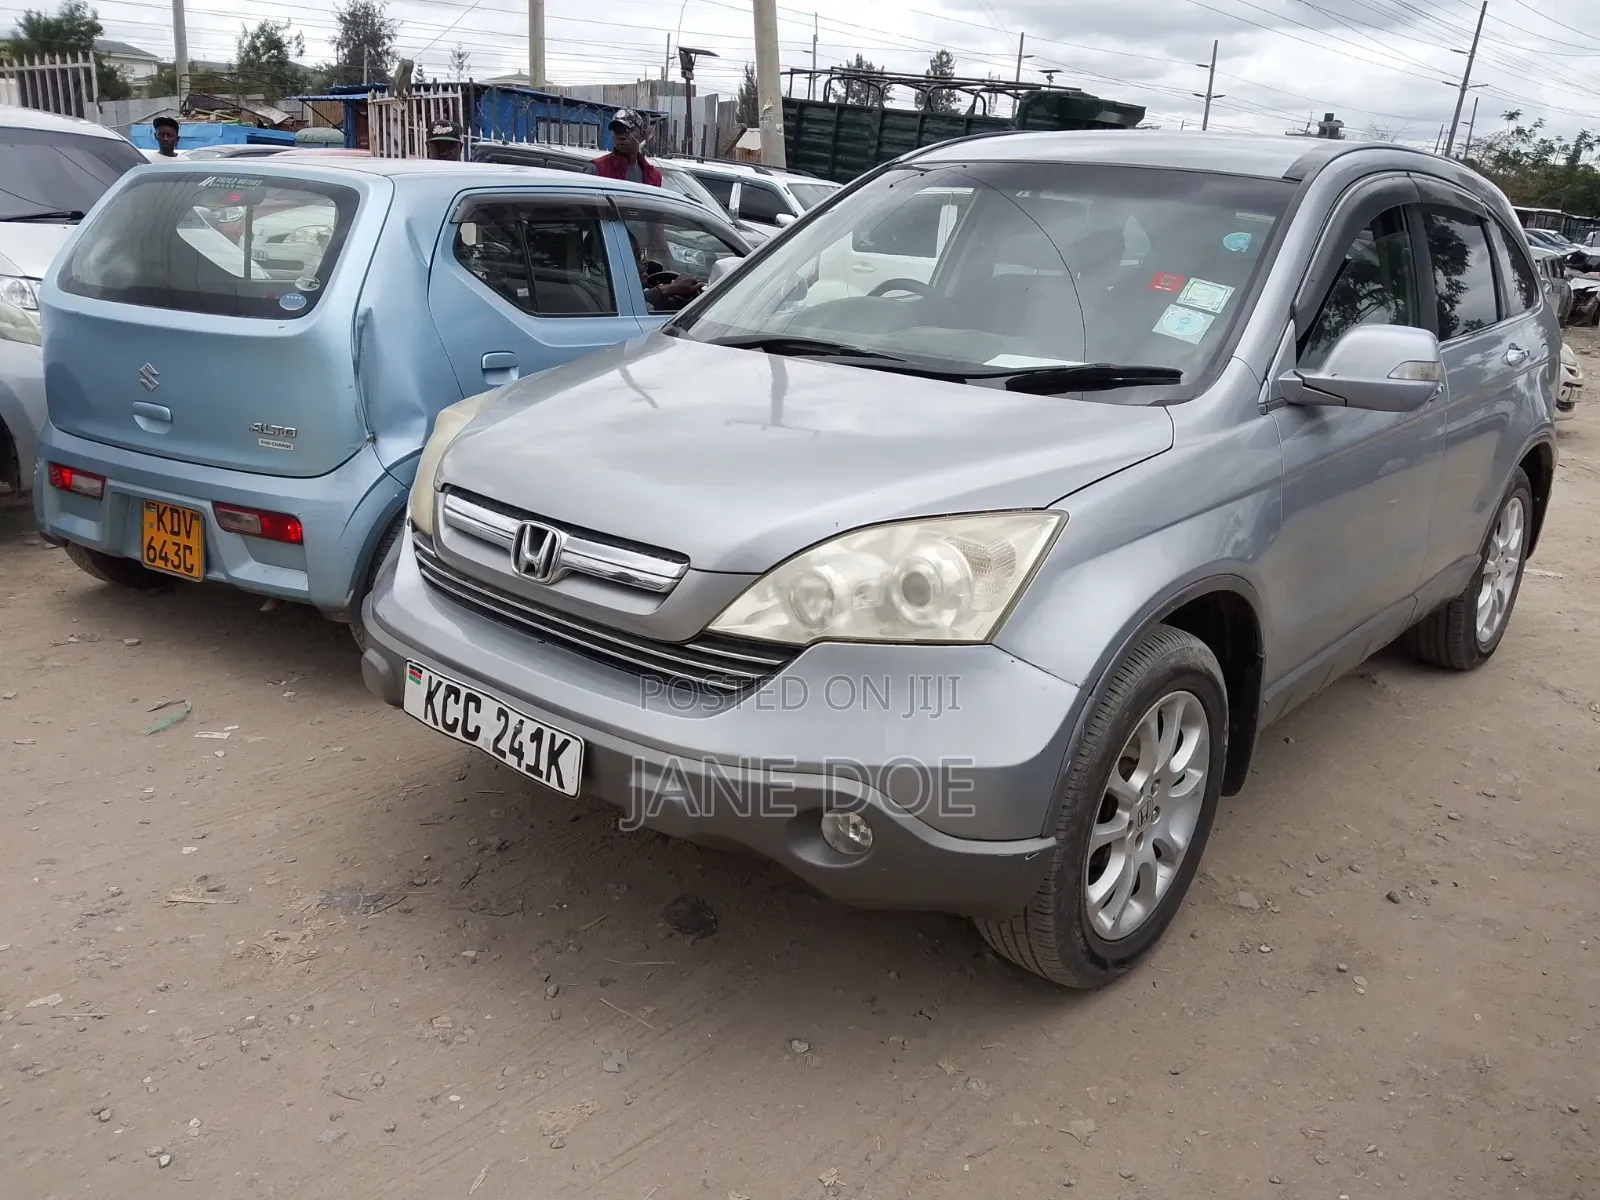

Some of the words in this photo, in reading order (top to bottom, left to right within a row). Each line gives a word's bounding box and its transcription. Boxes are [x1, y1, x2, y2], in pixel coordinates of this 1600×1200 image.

[249, 422, 298, 438] ALTO
[156, 504, 194, 540] KDV
[146, 535, 194, 574] 643C
[423, 675, 482, 742] KCC
[492, 706, 571, 790] 241K
